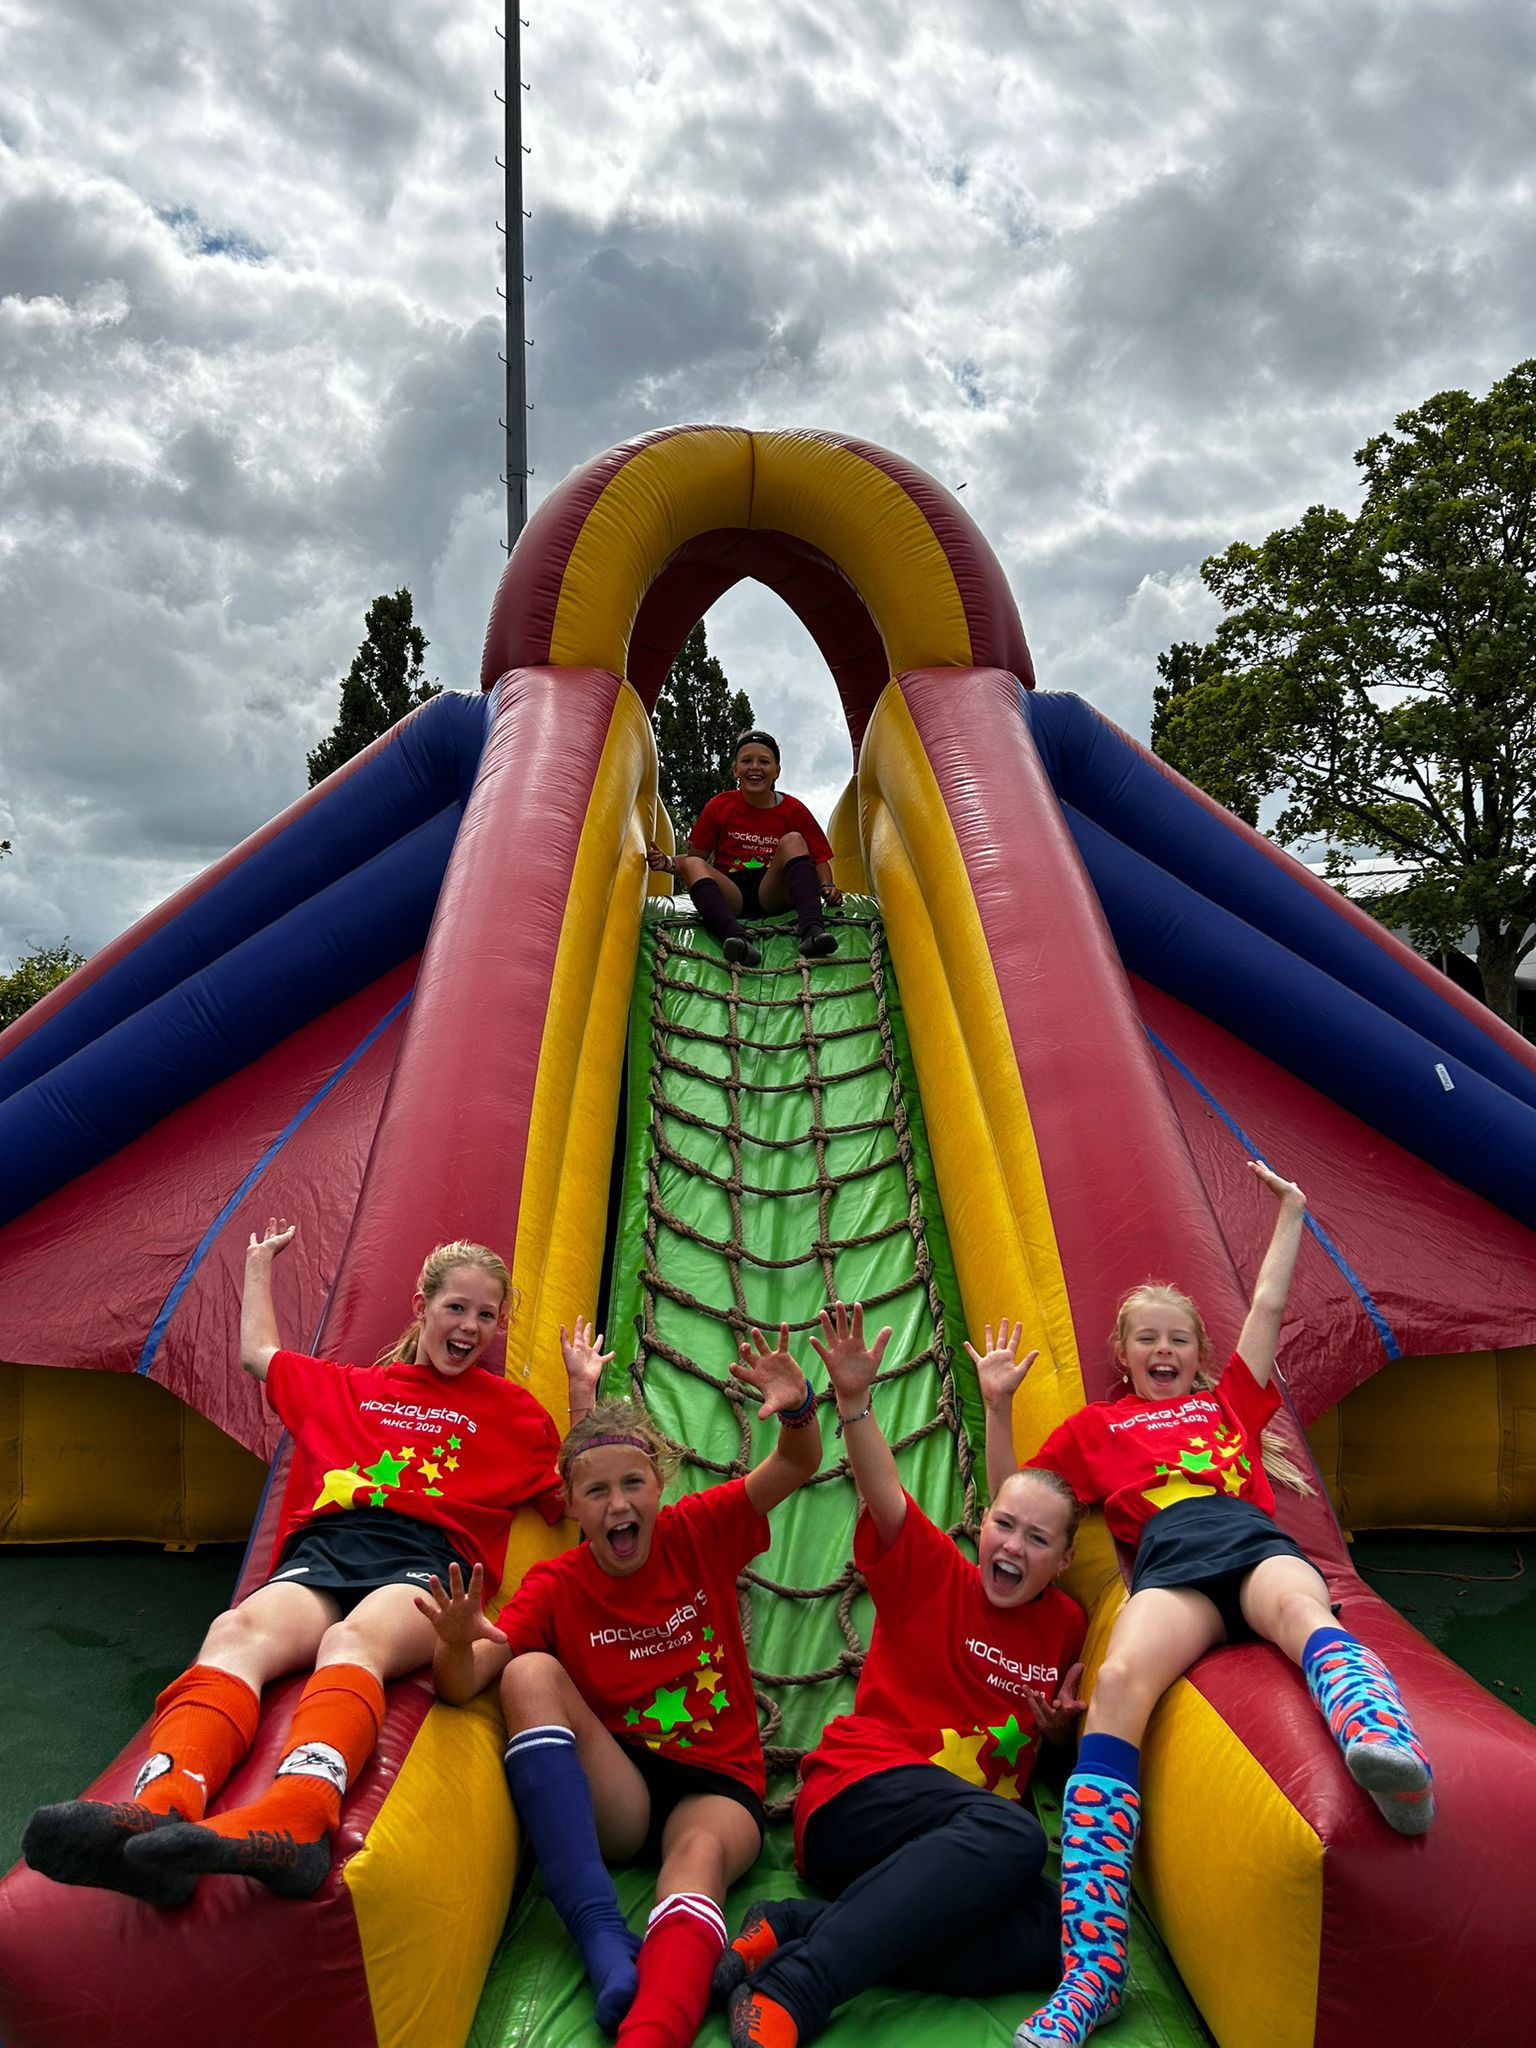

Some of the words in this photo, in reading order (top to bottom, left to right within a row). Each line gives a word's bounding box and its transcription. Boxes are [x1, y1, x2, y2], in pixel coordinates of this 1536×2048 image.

[728, 831, 779, 845] Hockeysta
[359, 1399, 478, 1434] Hockeystars
[380, 1417, 414, 1430] MHCC
[415, 1421, 442, 1434] 2023
[1108, 1398, 1220, 1433] Hockeystar
[1146, 1419, 1180, 1431] MHCC
[1181, 1413, 1209, 1424] 2023
[629, 1642, 665, 1661] MHCC
[666, 1630, 694, 1650] 2023
[965, 1637, 1058, 1682] Hockeysta
[986, 1673, 1021, 1695] MHCC
